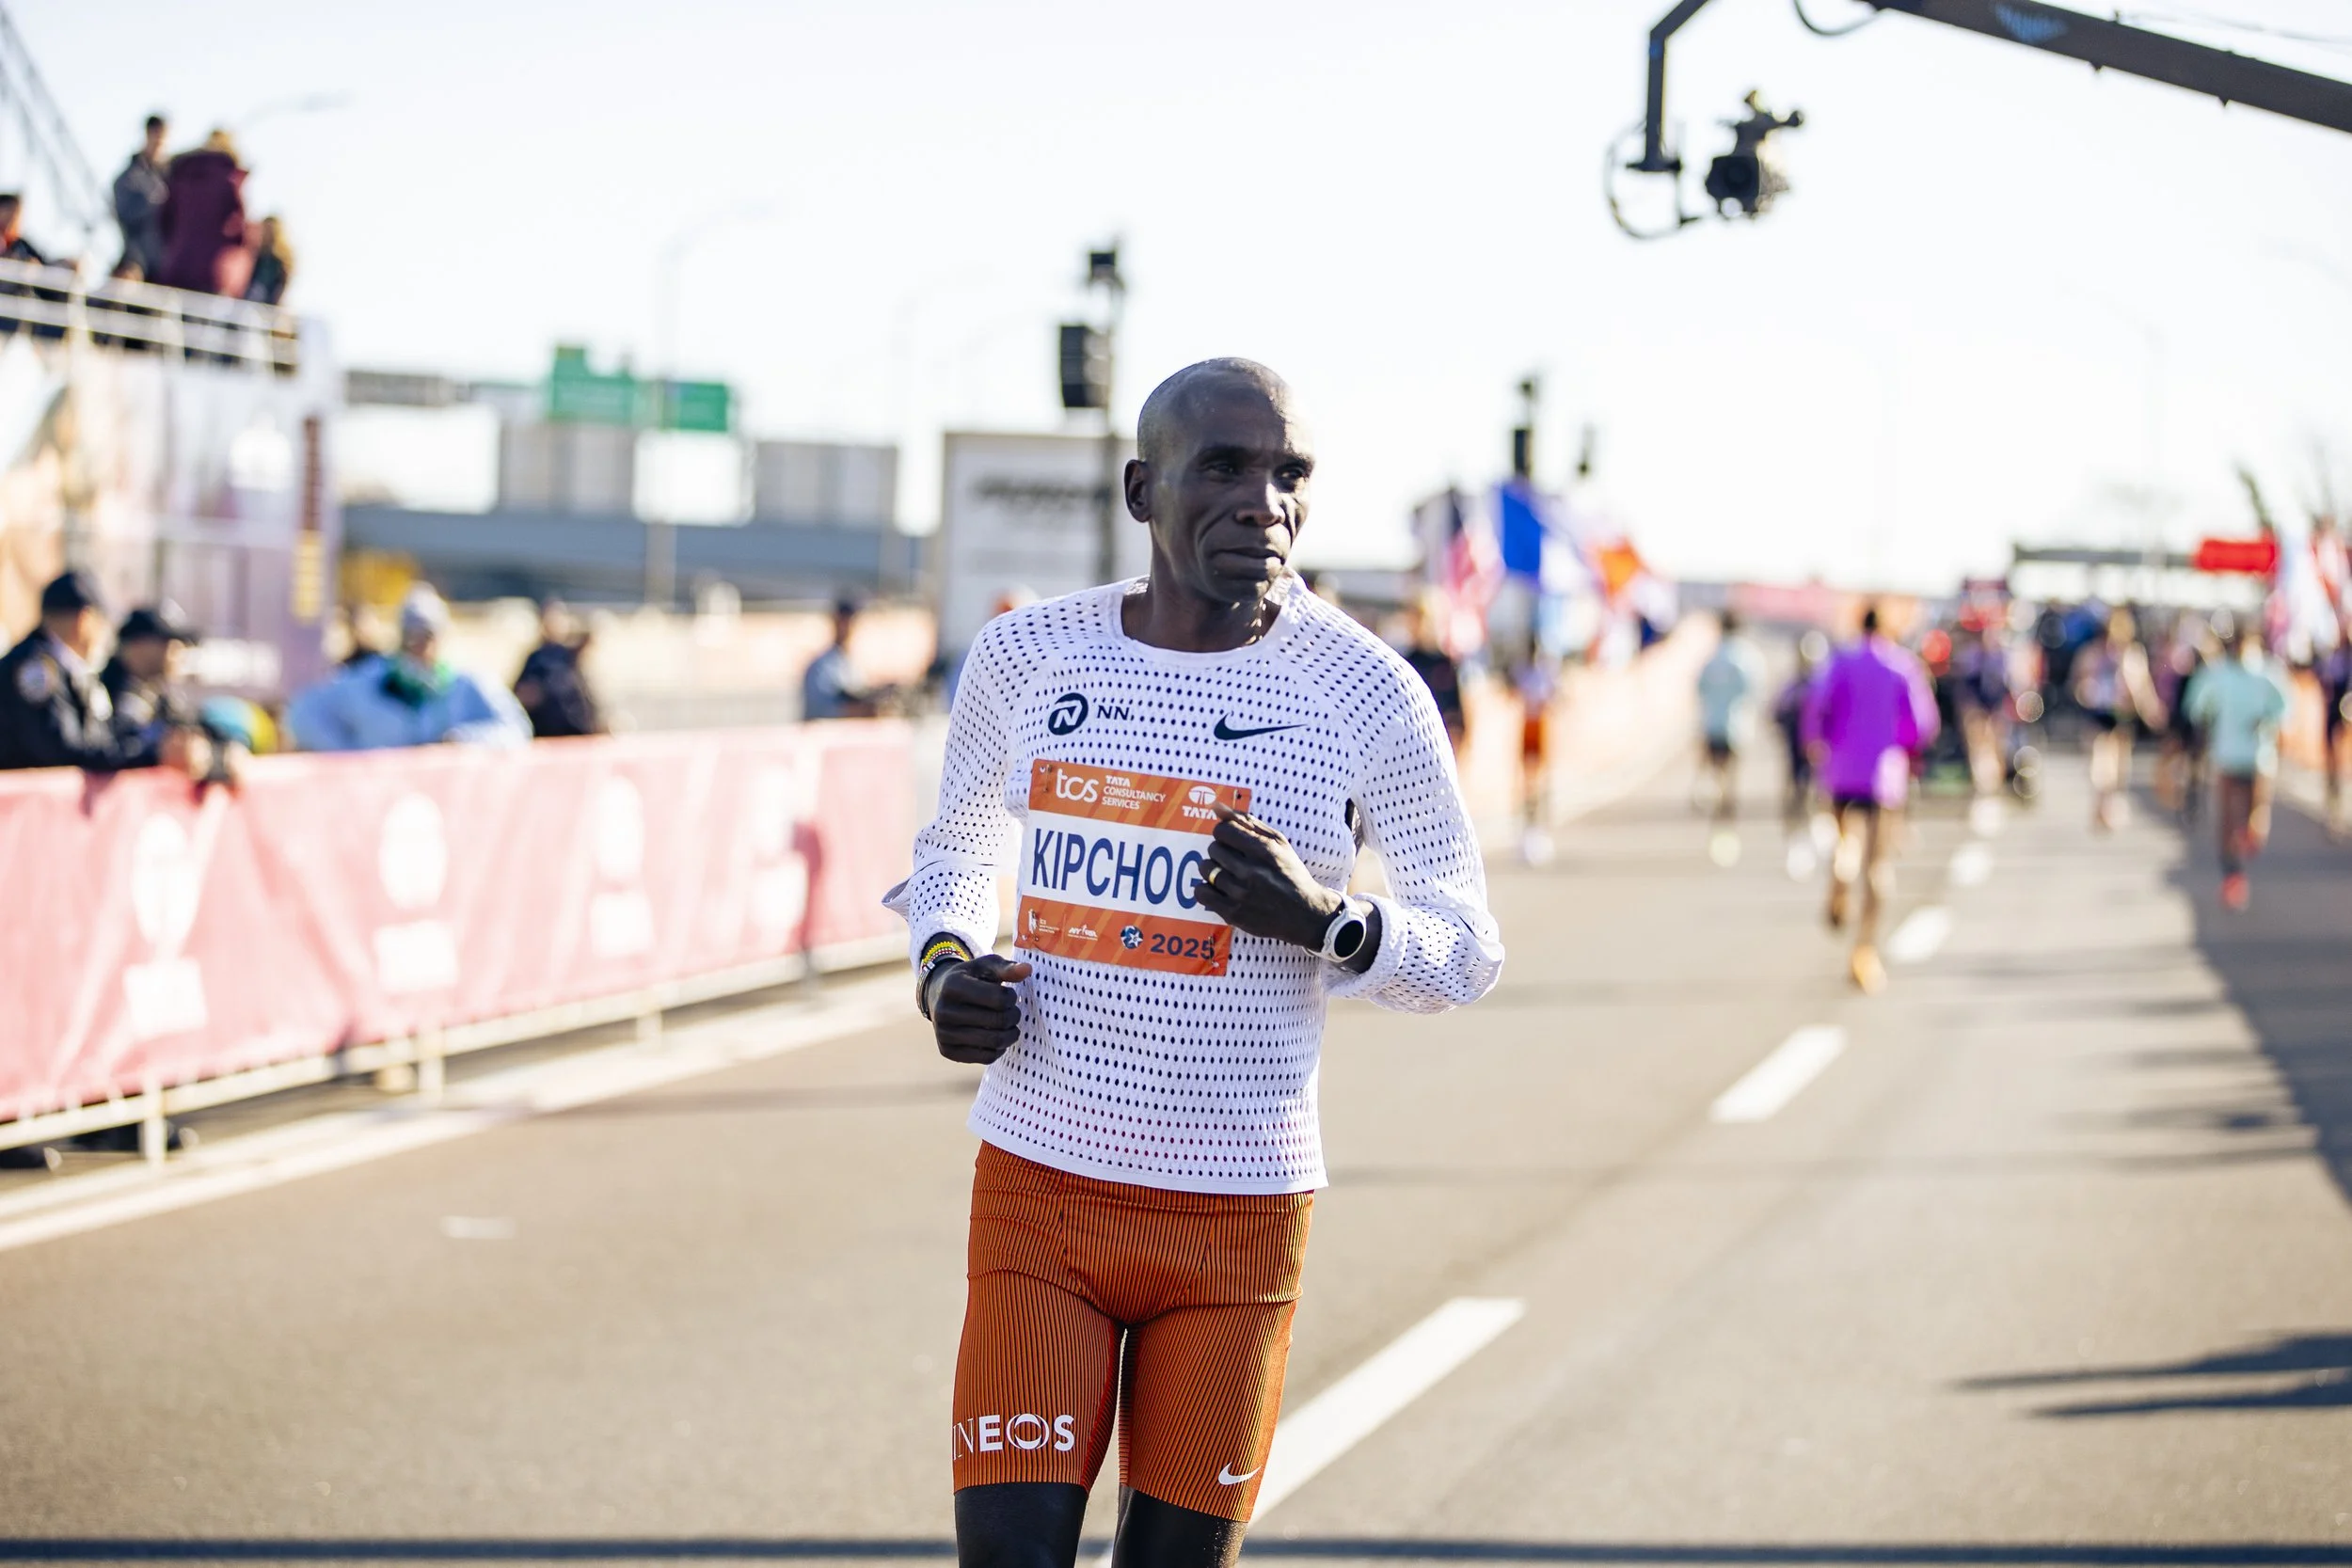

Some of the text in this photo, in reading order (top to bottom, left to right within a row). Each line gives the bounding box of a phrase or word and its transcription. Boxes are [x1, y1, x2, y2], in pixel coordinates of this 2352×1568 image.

[1096, 705, 1130, 721] NN
[1056, 768, 1100, 803] tcs
[1105, 775, 1131, 787] TATA
[1104, 786, 1167, 802] CONSULTANCY
[1102, 797, 1141, 810] SERVICES
[1182, 805, 1217, 820] TATA
[1032, 828, 1212, 911] KIPCHOG
[1150, 933, 1215, 960] 2025
